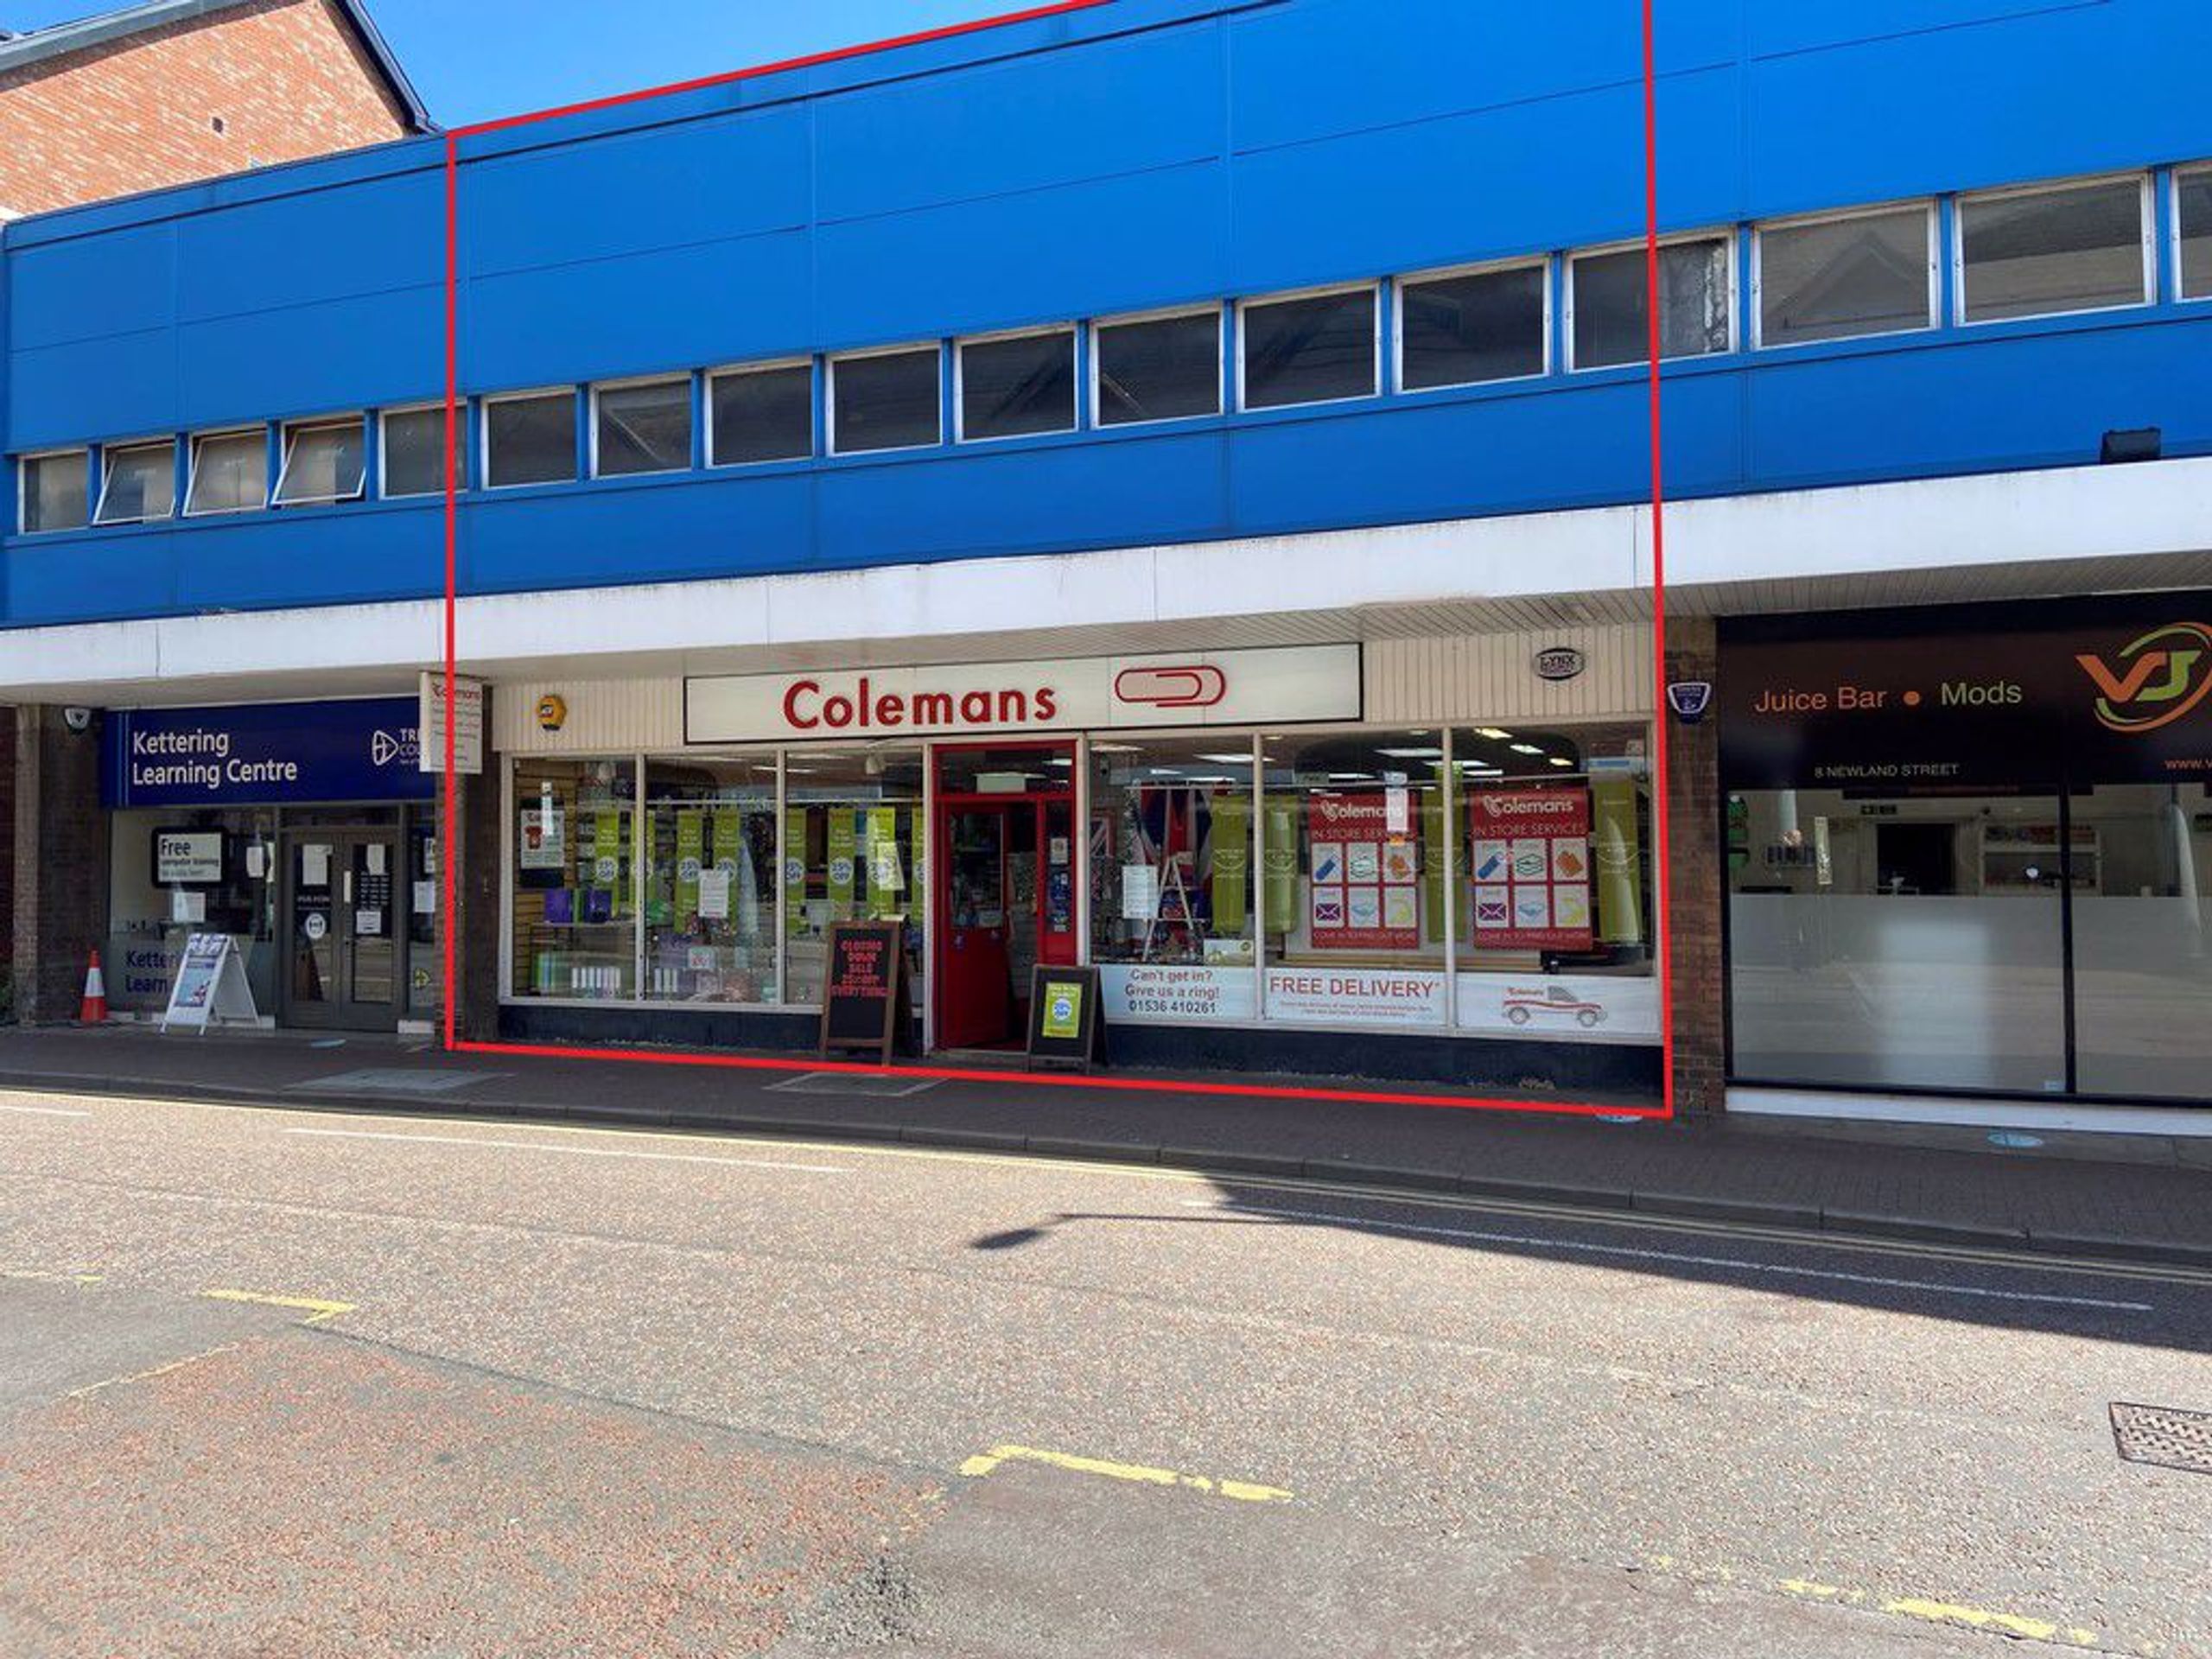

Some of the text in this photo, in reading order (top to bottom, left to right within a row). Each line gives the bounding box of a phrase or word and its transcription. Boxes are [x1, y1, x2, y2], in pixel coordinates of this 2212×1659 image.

[783, 677, 1057, 729] Colemans
[1755, 687, 1888, 713] Juice Bar
[1942, 681, 2023, 706] Mods
[133, 728, 229, 757] Kettering
[133, 759, 297, 789] Learning Centre
[1815, 763, 1960, 778] 8 NEWLAND STREET
[1483, 795, 1574, 817] Colemans
[1531, 823, 1587, 836] SERVICES
[161, 837, 191, 856] Free
[1130, 968, 1214, 983] Can't get in?
[1125, 983, 1220, 1001] Give us a ring!
[1270, 976, 1324, 995] FREE
[1129, 1000, 1217, 1014] 01536 410261
